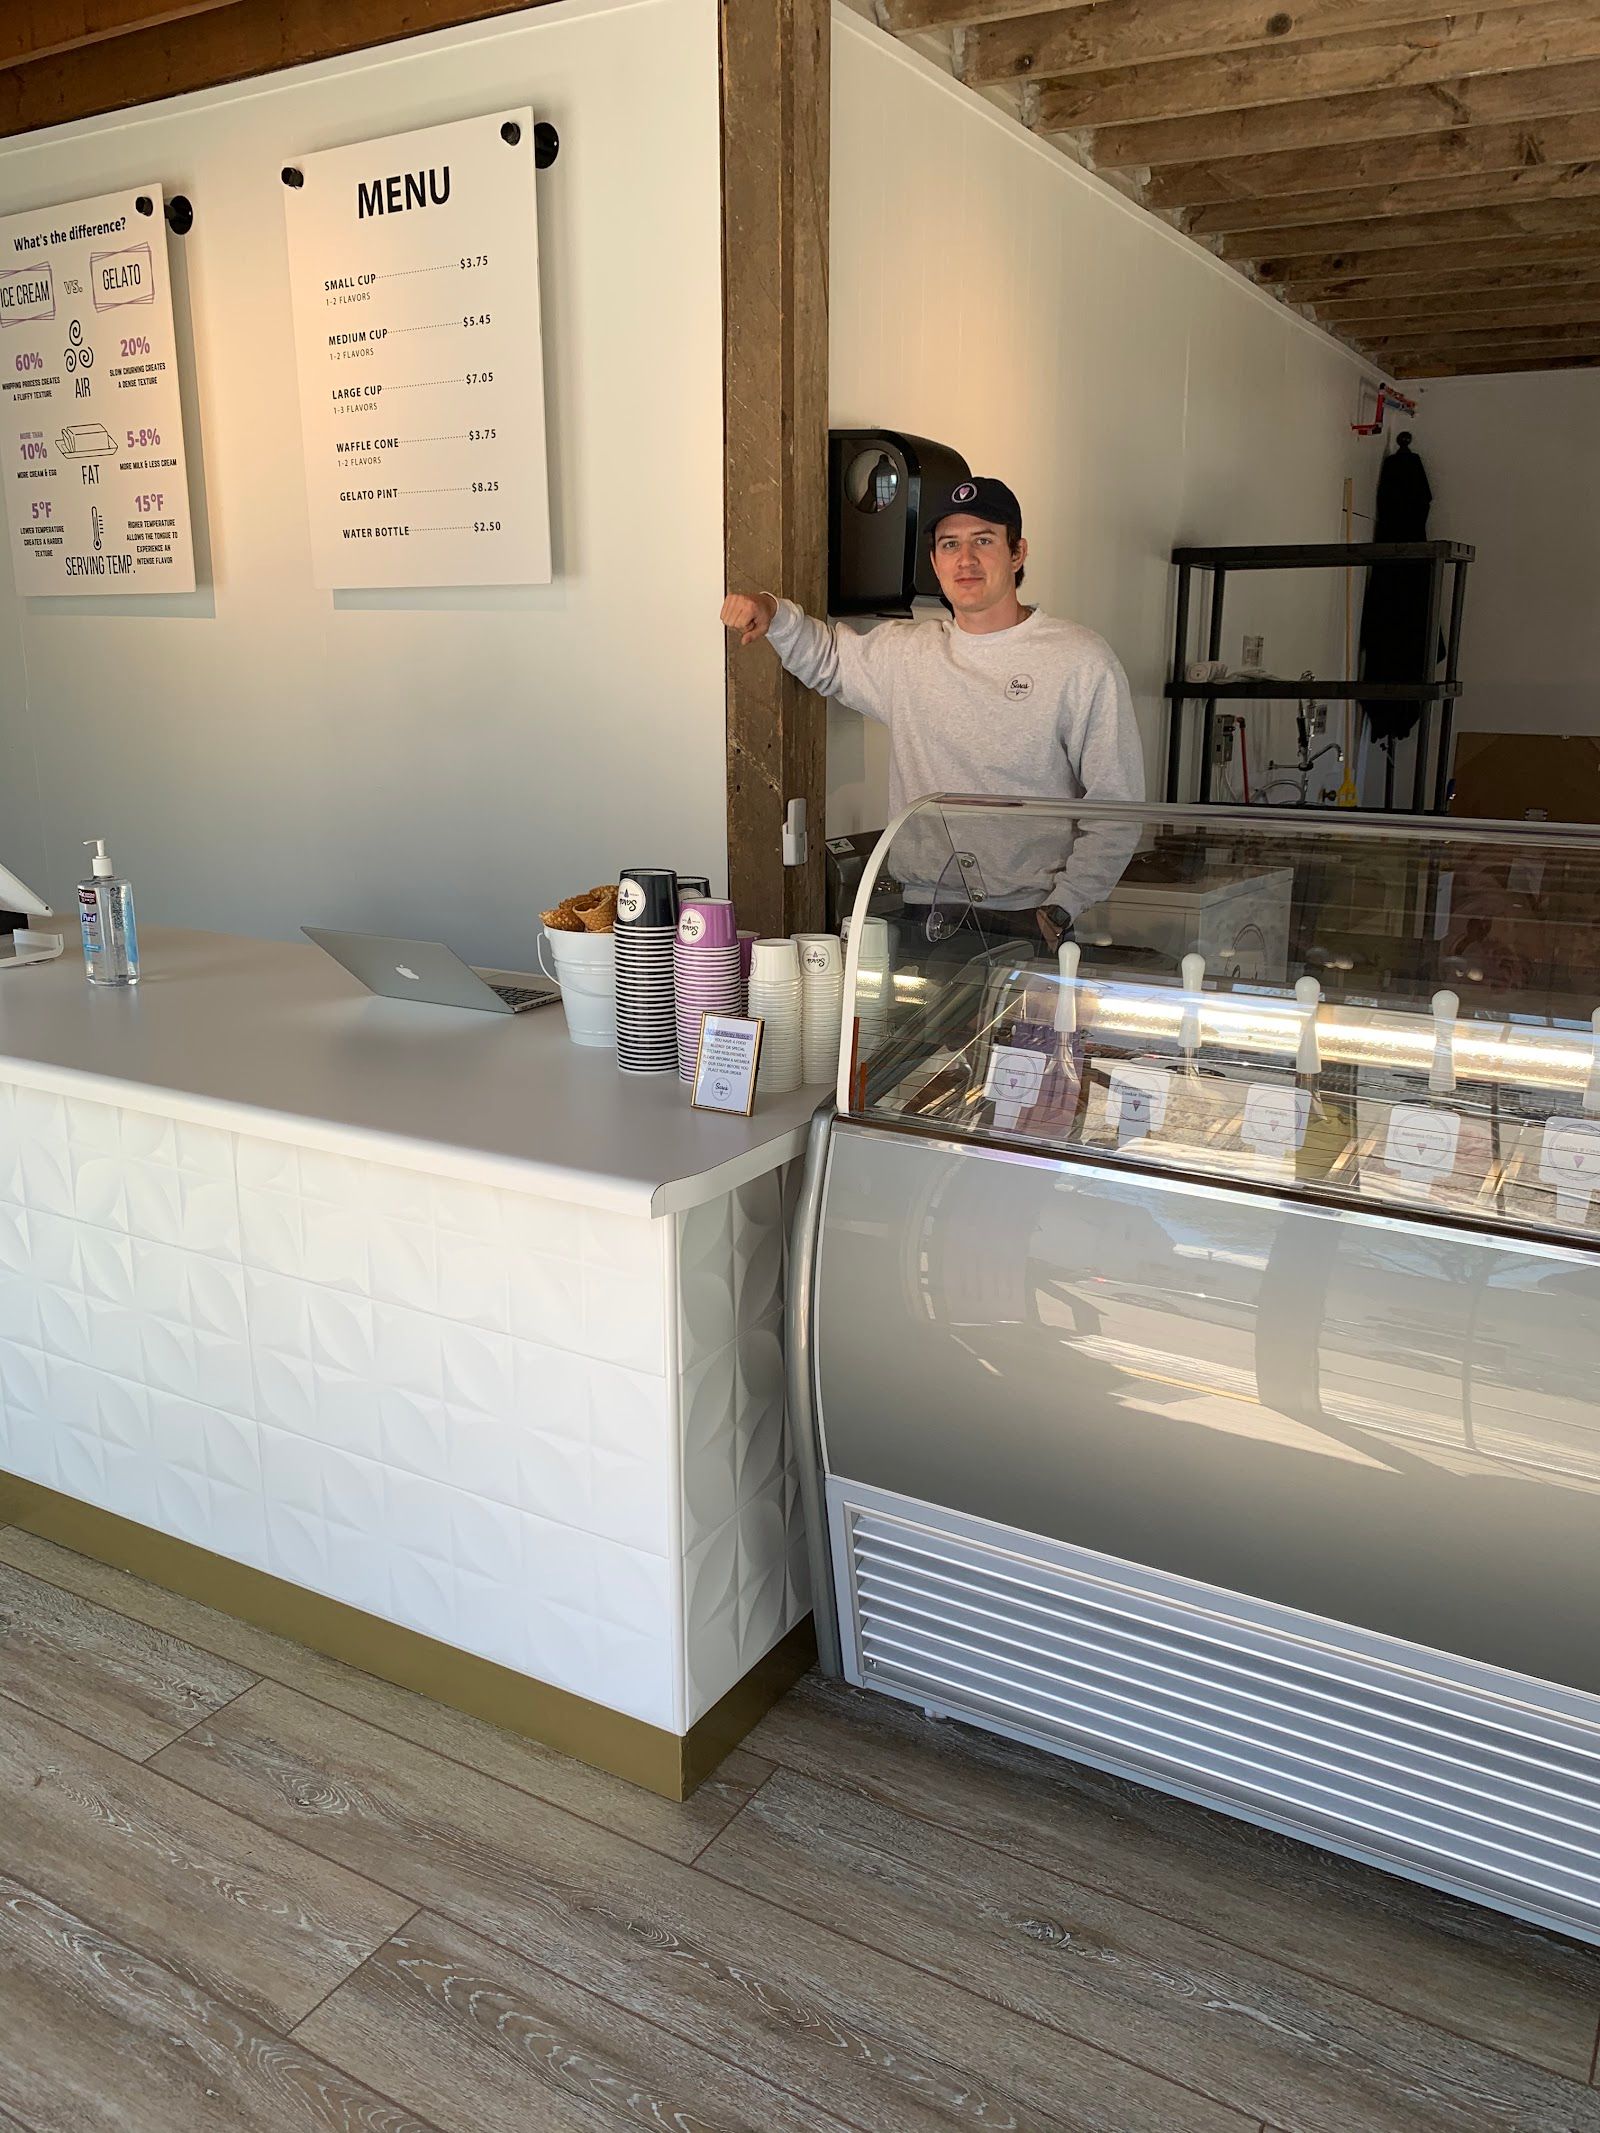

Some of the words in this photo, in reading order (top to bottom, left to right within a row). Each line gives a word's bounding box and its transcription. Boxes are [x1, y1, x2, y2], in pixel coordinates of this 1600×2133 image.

[357, 165, 451, 220] MENU
[14, 234, 48, 251] What's
[50, 230, 67, 244] the
[69, 217, 126, 240] difference?
[102, 263, 141, 291] GELATO
[324, 277, 355, 291] SMALL
[357, 273, 377, 286] CUP
[459, 255, 489, 270] $3.75
[0, 286, 14, 308] ICE
[16, 280, 50, 305] CREAM
[325, 297, 337, 307] 1-2
[339, 291, 371, 304] FLAVORS
[328, 331, 367, 346] MEDIUM
[369, 328, 388, 340] CUP
[462, 314, 491, 328] $5.45
[120, 336, 150, 357] 20%
[329, 352, 341, 361] 1-2
[343, 347, 375, 360] FLAVORS
[15, 352, 43, 372] 60%
[109, 368, 122, 377] SLOW
[123, 365, 144, 375] CHURNING
[145, 362, 166, 372] CREATES
[42, 376, 60, 385] CREATES
[75, 377, 91, 398] AIR
[122, 379, 137, 388] DENSE
[138, 377, 157, 386] TEXTURE
[332, 387, 361, 400] LARGE
[364, 384, 383, 397] CUP
[465, 372, 494, 385] $7.05
[17, 392, 33, 401] FLUFFY
[33, 390, 52, 399] TEXTURE
[333, 406, 345, 415] 1-3
[346, 402, 378, 414] FLAVORS
[127, 428, 161, 448] 5-8%
[336, 440, 372, 453] WAFFLE
[374, 438, 400, 450] CONE
[468, 429, 497, 442] $3.75
[20, 442, 47, 460] 10%
[120, 462, 132, 470] MORE
[132, 461, 143, 469] MILK
[144, 460, 148, 469] &
[148, 459, 160, 468] LESS
[160, 458, 177, 467] CREAM
[337, 459, 349, 468] 1-2
[350, 456, 382, 466] FLAVORS
[17, 471, 29, 479] MORE
[29, 470, 44, 478] CREAM
[81, 464, 100, 485] FAT
[339, 490, 375, 502] GELATO
[376, 488, 399, 500] PINT
[471, 481, 499, 493] $8.25
[31, 501, 52, 519] 5°F
[135, 493, 164, 513] 15°F
[20, 527, 35, 535] LOWER
[35, 525, 64, 534] TEMPERATURE
[144, 519, 175, 528] TEMPERATURE
[342, 528, 373, 539] WATER
[375, 526, 410, 537] BOTTLE
[473, 521, 502, 533] $2.50
[23, 538, 42, 546] CREATES
[126, 533, 145, 541] ALLOWS
[145, 532, 153, 540] THE
[154, 531, 171, 539] TONGUE
[171, 531, 178, 539] TO
[136, 545, 164, 553] EXPERIENCE
[164, 544, 171, 552] AN
[65, 555, 105, 576] SERVING
[106, 554, 136, 575] TEMP.
[136, 557, 155, 565] INTENSE
[155, 556, 173, 565] FLAVOR
